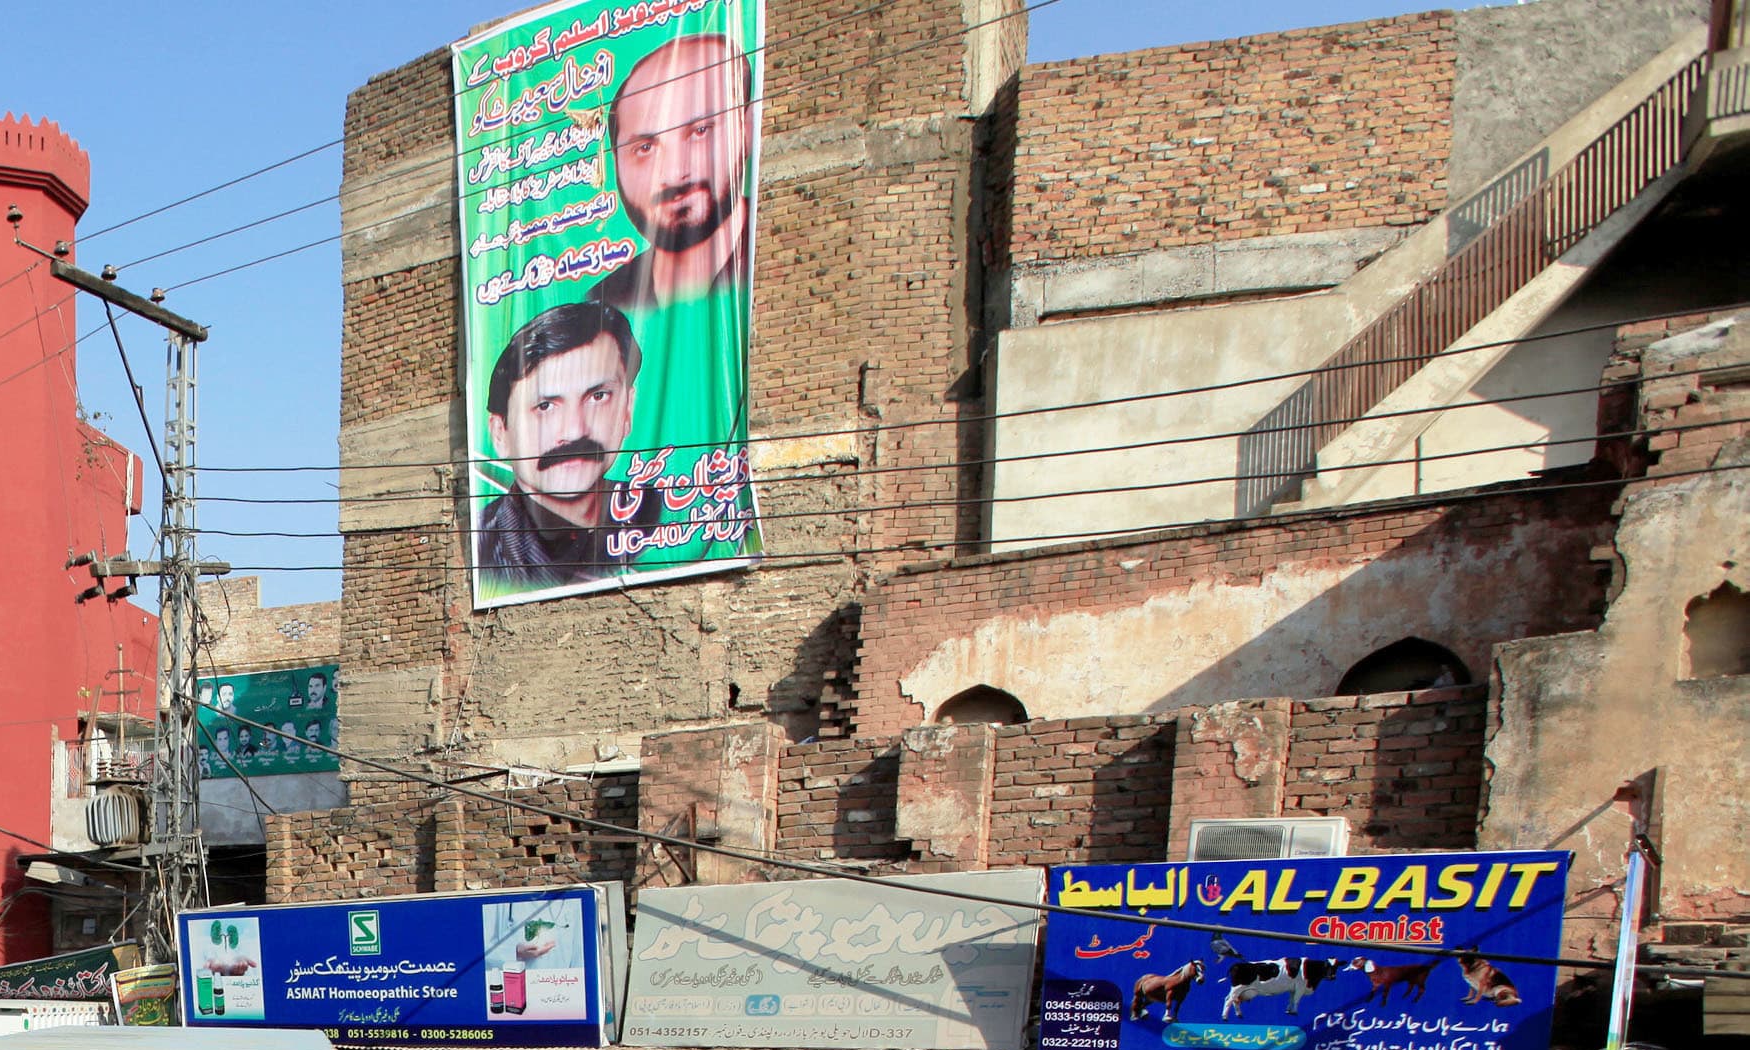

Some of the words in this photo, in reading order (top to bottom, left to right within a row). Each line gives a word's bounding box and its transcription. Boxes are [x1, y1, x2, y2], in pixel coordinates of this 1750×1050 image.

[606, 523, 681, 558] UC-40
[1058, 866, 1188, 914] الباسط
[1218, 861, 1560, 913] AL-BASIT
[1307, 916, 1444, 942] Chemist
[399, 960, 457, 975] عصمت
[286, 987, 327, 1000] ASMAT
[329, 986, 419, 1001] Homoeopathic
[422, 985, 458, 998] Store
[1045, 1000, 1120, 1011] 0345-5088984
[1044, 1012, 1119, 1022] 0333-5199256
[629, 1027, 709, 1037] 051-4352157
[1450, 1018, 1508, 1033] ہمارے
[347, 1028, 409, 1039] 051-5539816
[420, 1029, 494, 1040] 0300-5286065
[1041, 1037, 1118, 1049] 0322-2221913
